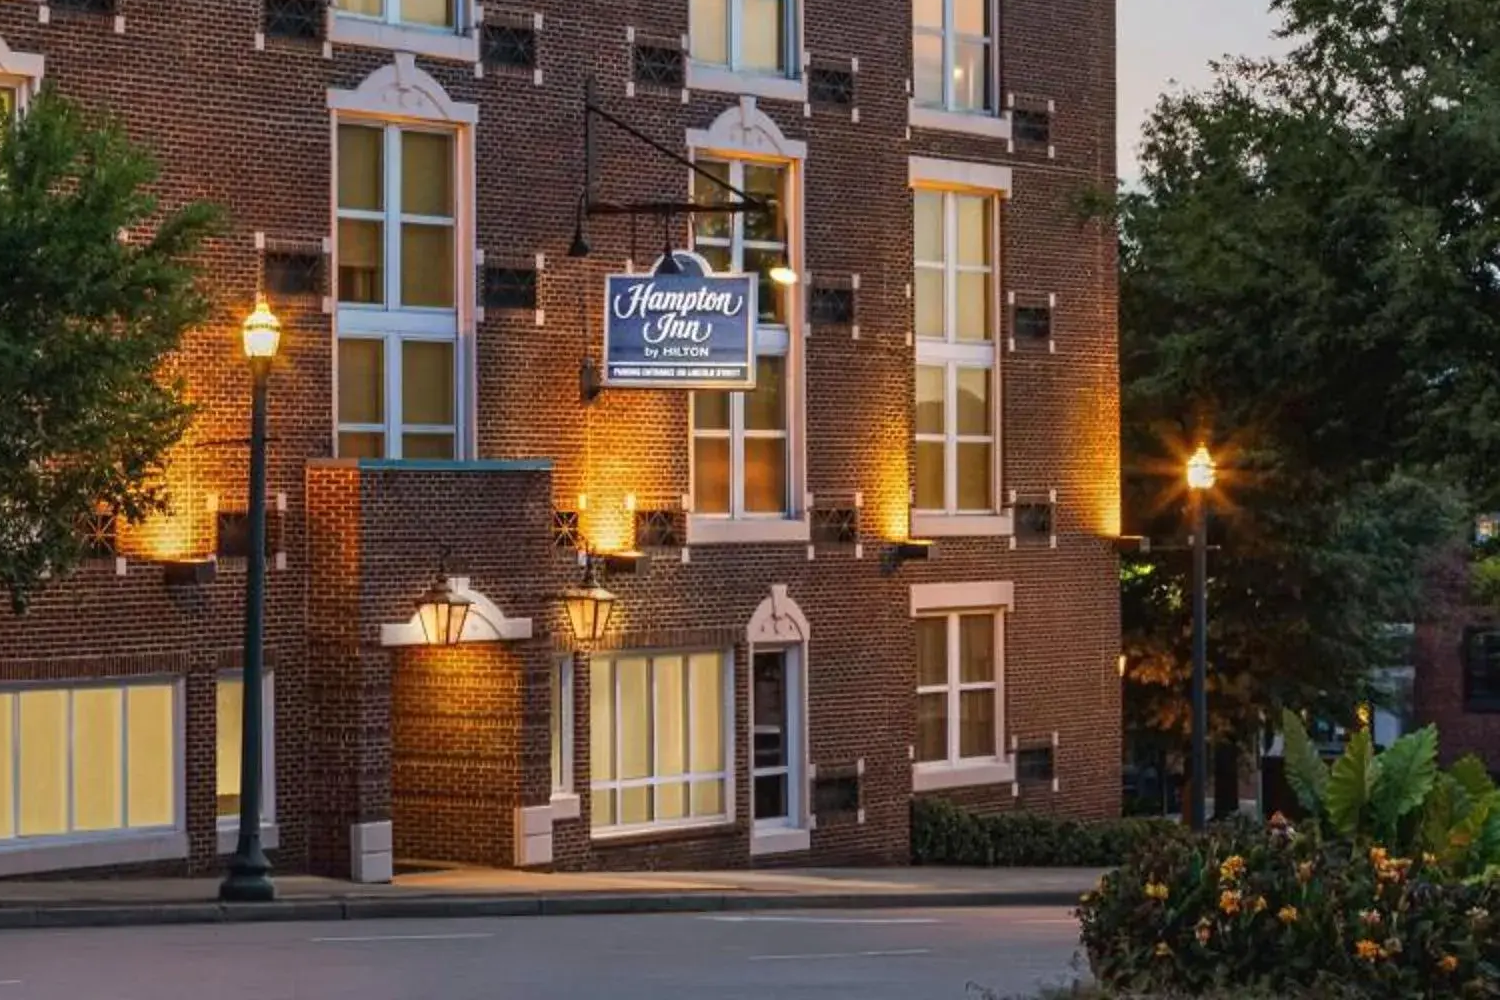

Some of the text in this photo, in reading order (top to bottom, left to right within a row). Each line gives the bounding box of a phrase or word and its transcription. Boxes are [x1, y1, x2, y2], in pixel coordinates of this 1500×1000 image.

[613, 282, 743, 318] Hampton
[643, 312, 712, 343] Inn
[644, 346, 709, 358] by HILTON
